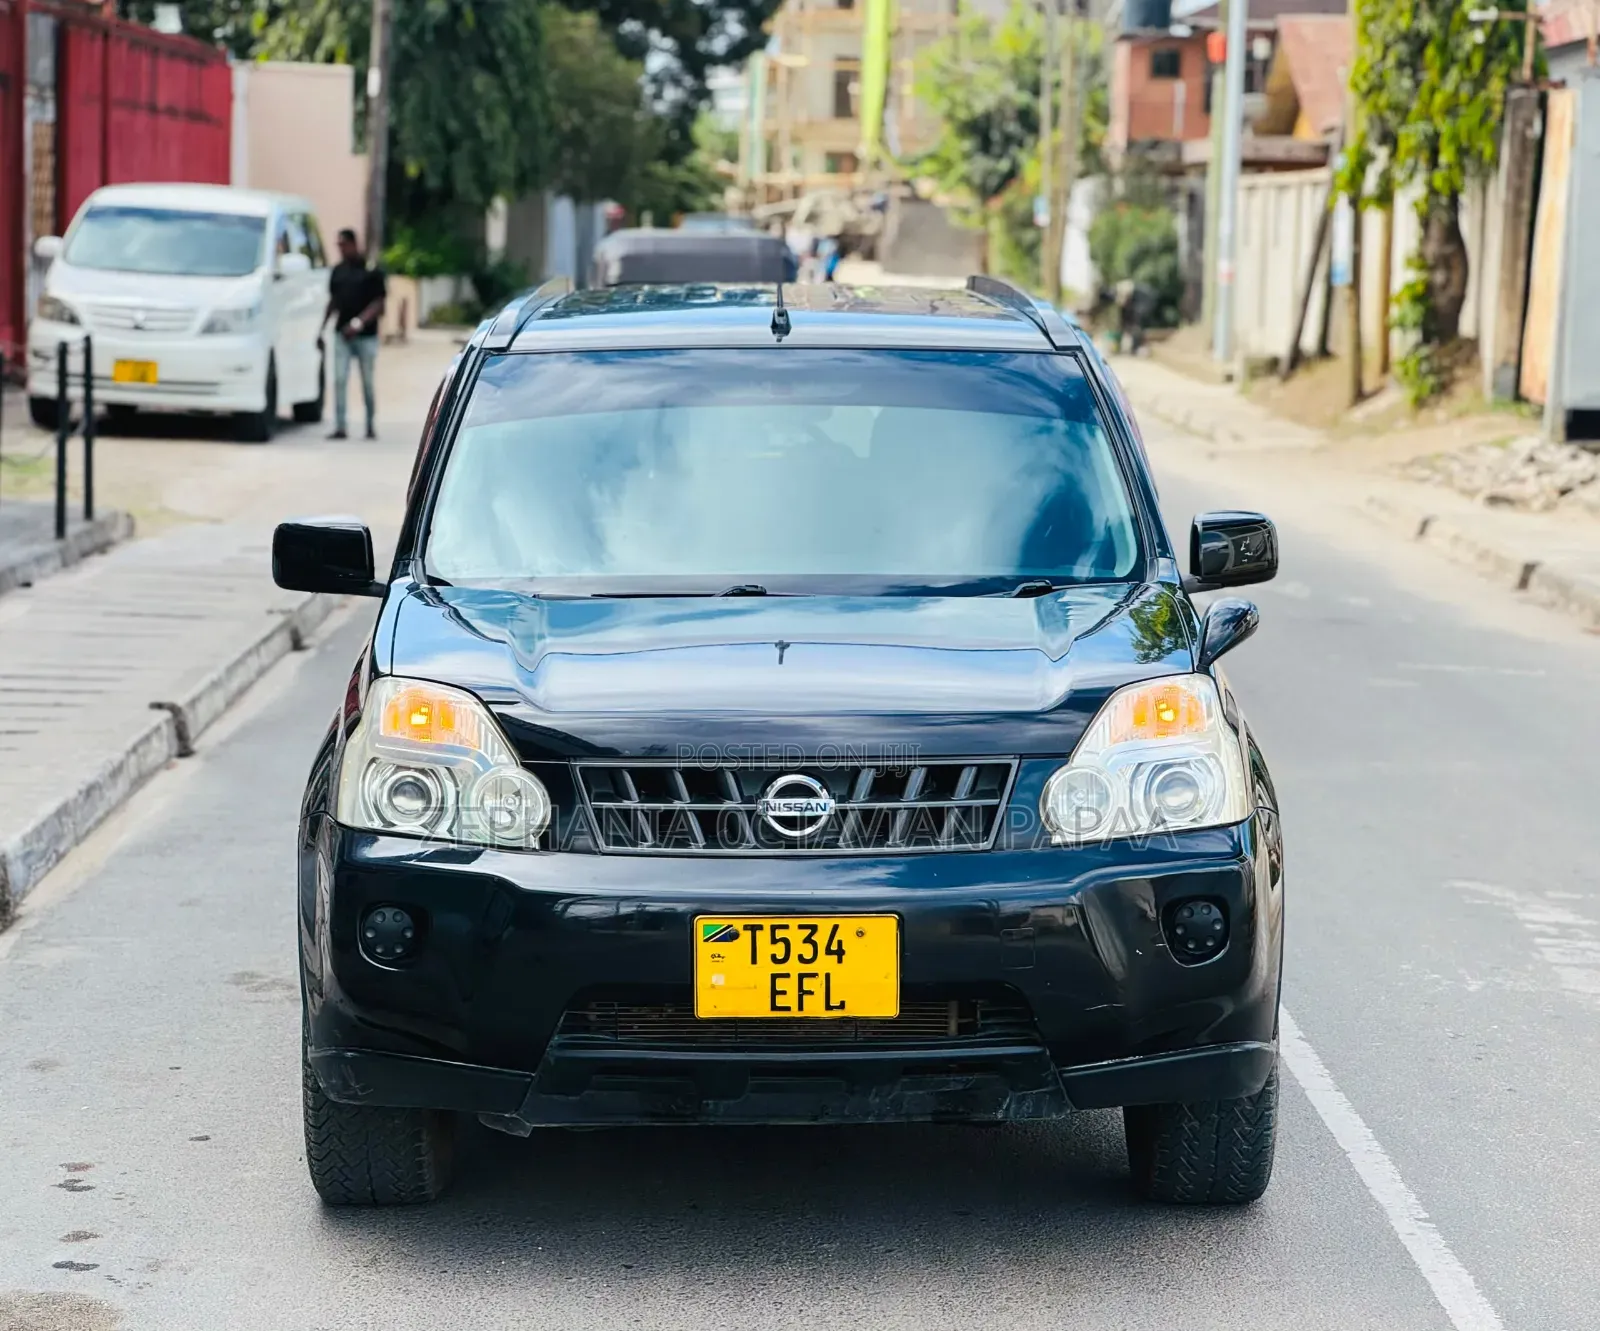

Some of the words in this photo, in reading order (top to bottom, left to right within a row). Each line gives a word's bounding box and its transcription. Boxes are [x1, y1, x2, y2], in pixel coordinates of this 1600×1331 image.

[765, 802, 827, 813] NISSAN
[742, 923, 846, 965] T534
[769, 972, 846, 1012] EFL
